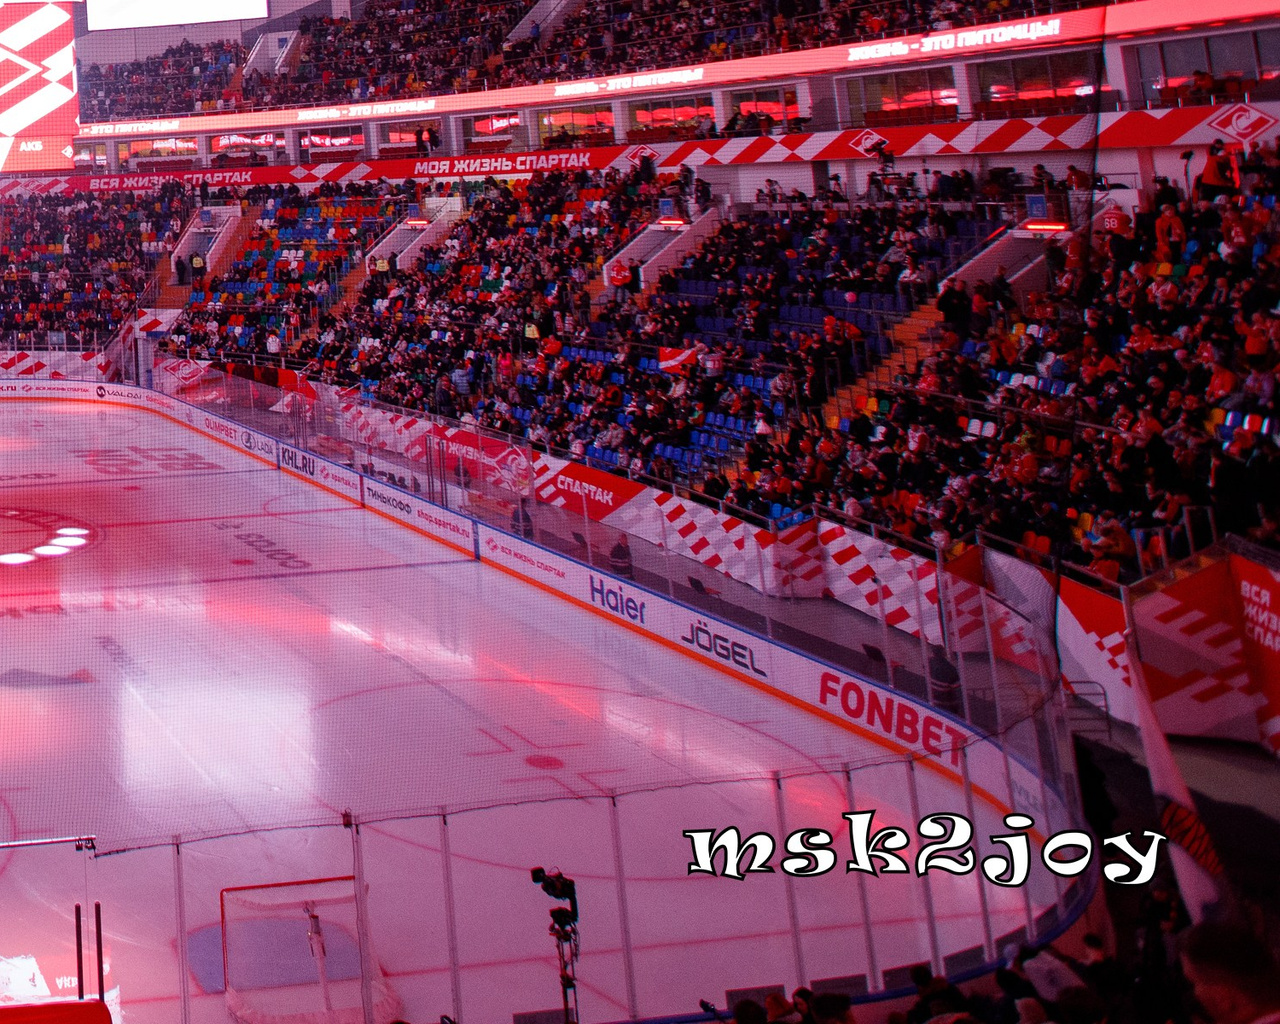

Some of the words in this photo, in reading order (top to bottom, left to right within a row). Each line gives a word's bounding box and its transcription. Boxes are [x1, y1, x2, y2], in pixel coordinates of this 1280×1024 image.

[20, 141, 43, 151] АКБ
[414, 161, 450, 175] МОЯ
[89, 176, 121, 190] ВСЯ
[107, 390, 142, 399] VALDAI
[257, 440, 273, 455] LADA
[281, 447, 315, 476] KHL.RU
[367, 487, 412, 515] ТИНЬКОФФ
[557, 475, 613, 506] СПАРТАК
[417, 509, 470, 538] shop.spartak.ru
[536, 560, 566, 579] СПАРТАК
[589, 574, 646, 625] Haier
[1240, 579, 1271, 607] ВСЯ
[680, 619, 768, 678] JÖGEL
[819, 671, 969, 768] FONBET
